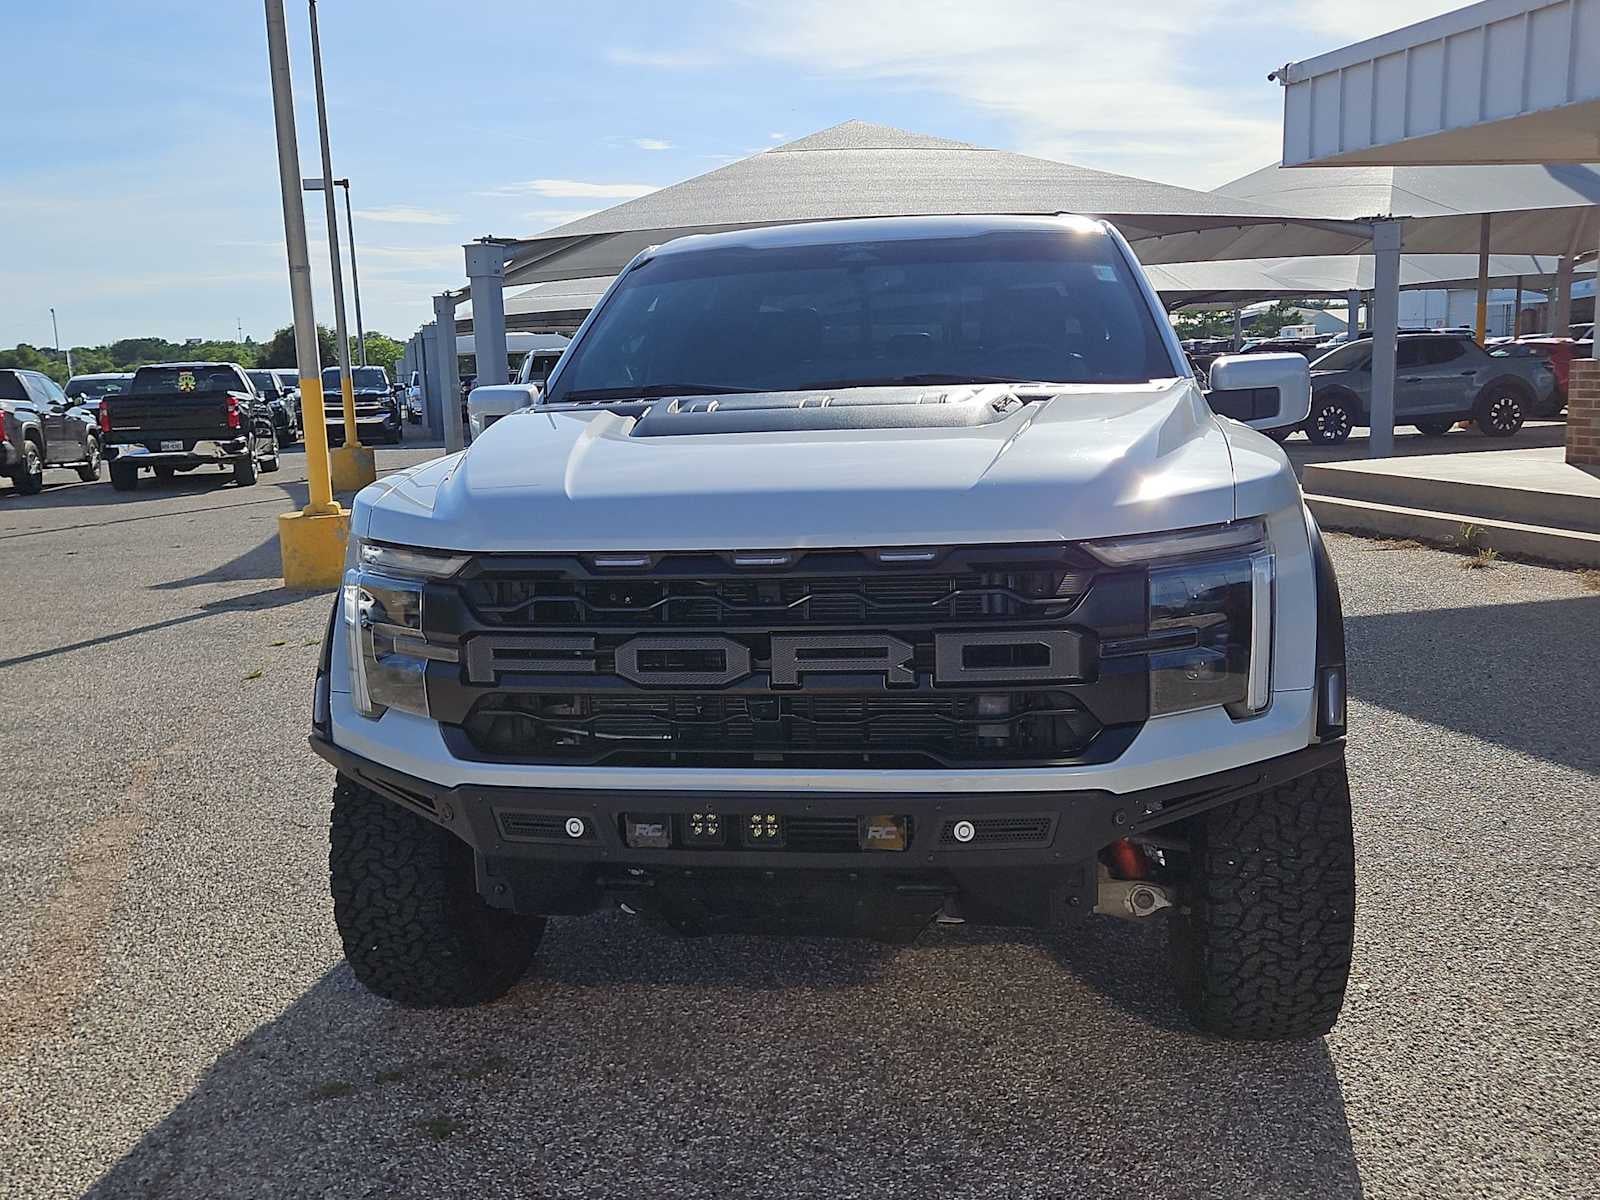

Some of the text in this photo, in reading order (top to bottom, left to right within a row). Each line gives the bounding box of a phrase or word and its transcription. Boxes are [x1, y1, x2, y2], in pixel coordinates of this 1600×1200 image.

[466, 630, 1083, 688] FORD
[635, 823, 663, 836] RC
[868, 826, 897, 839] RC
